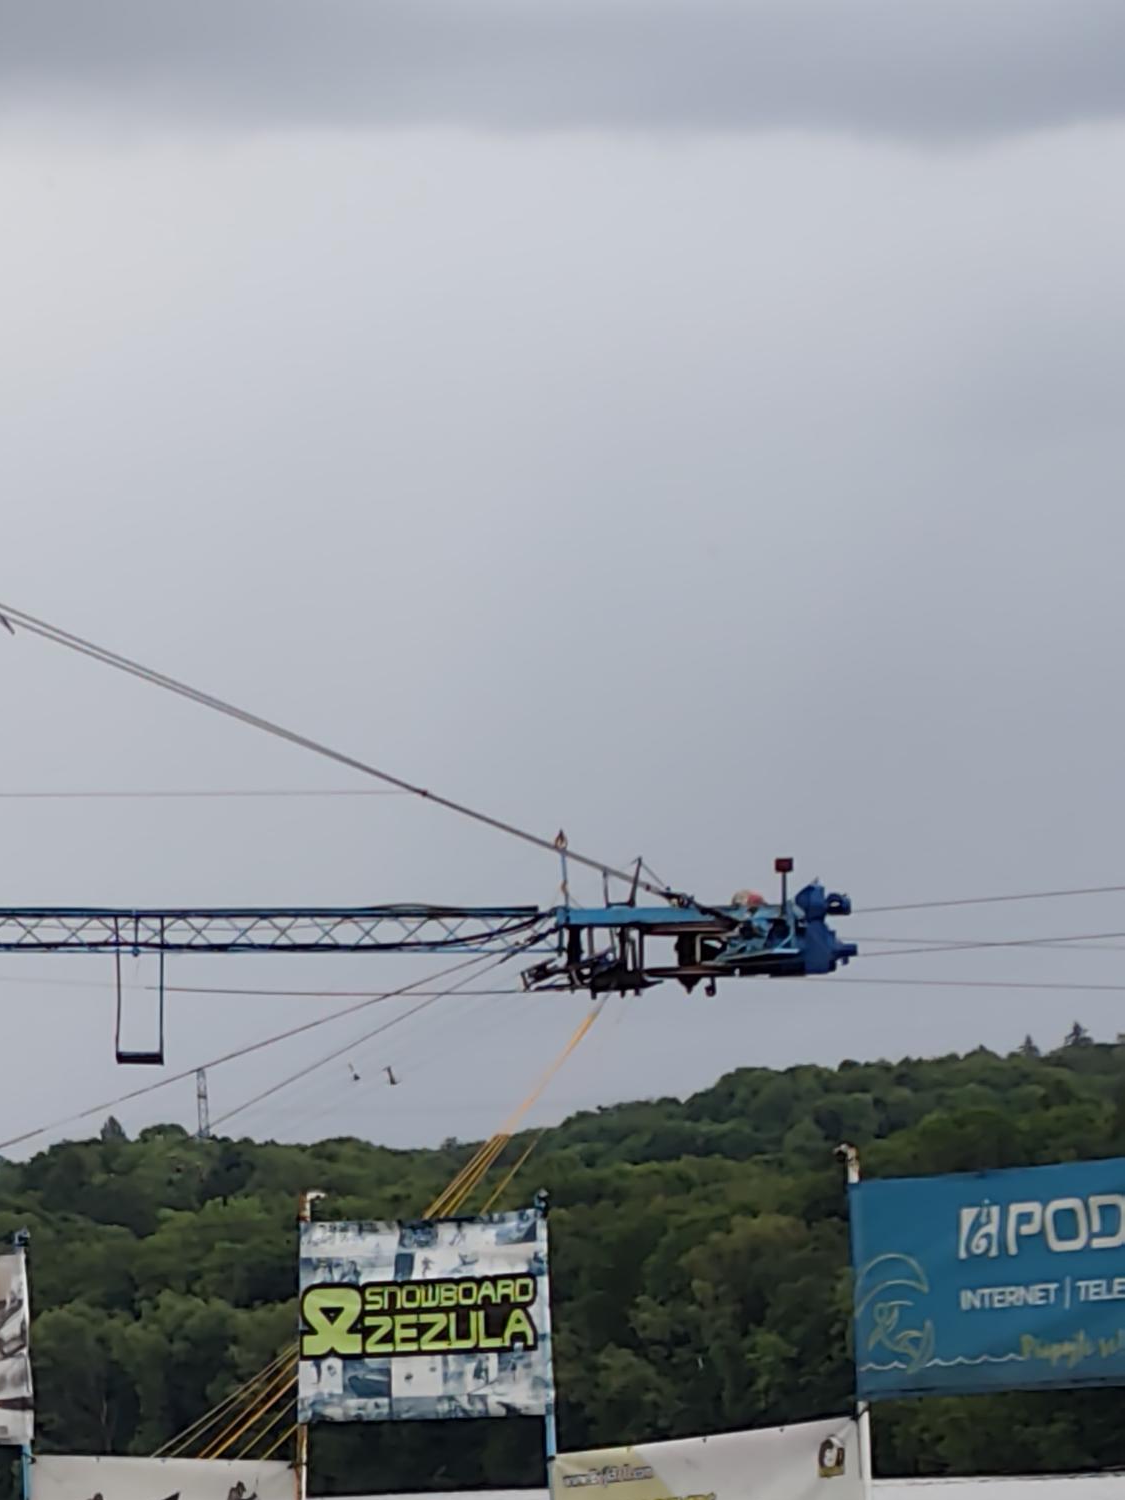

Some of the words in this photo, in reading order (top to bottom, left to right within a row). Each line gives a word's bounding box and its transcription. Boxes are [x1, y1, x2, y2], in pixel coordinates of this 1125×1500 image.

[364, 1277, 535, 1311] SNOWBOARD
[960, 1283, 1059, 1311] INTERNET
[364, 1308, 534, 1354] ZEZULA
